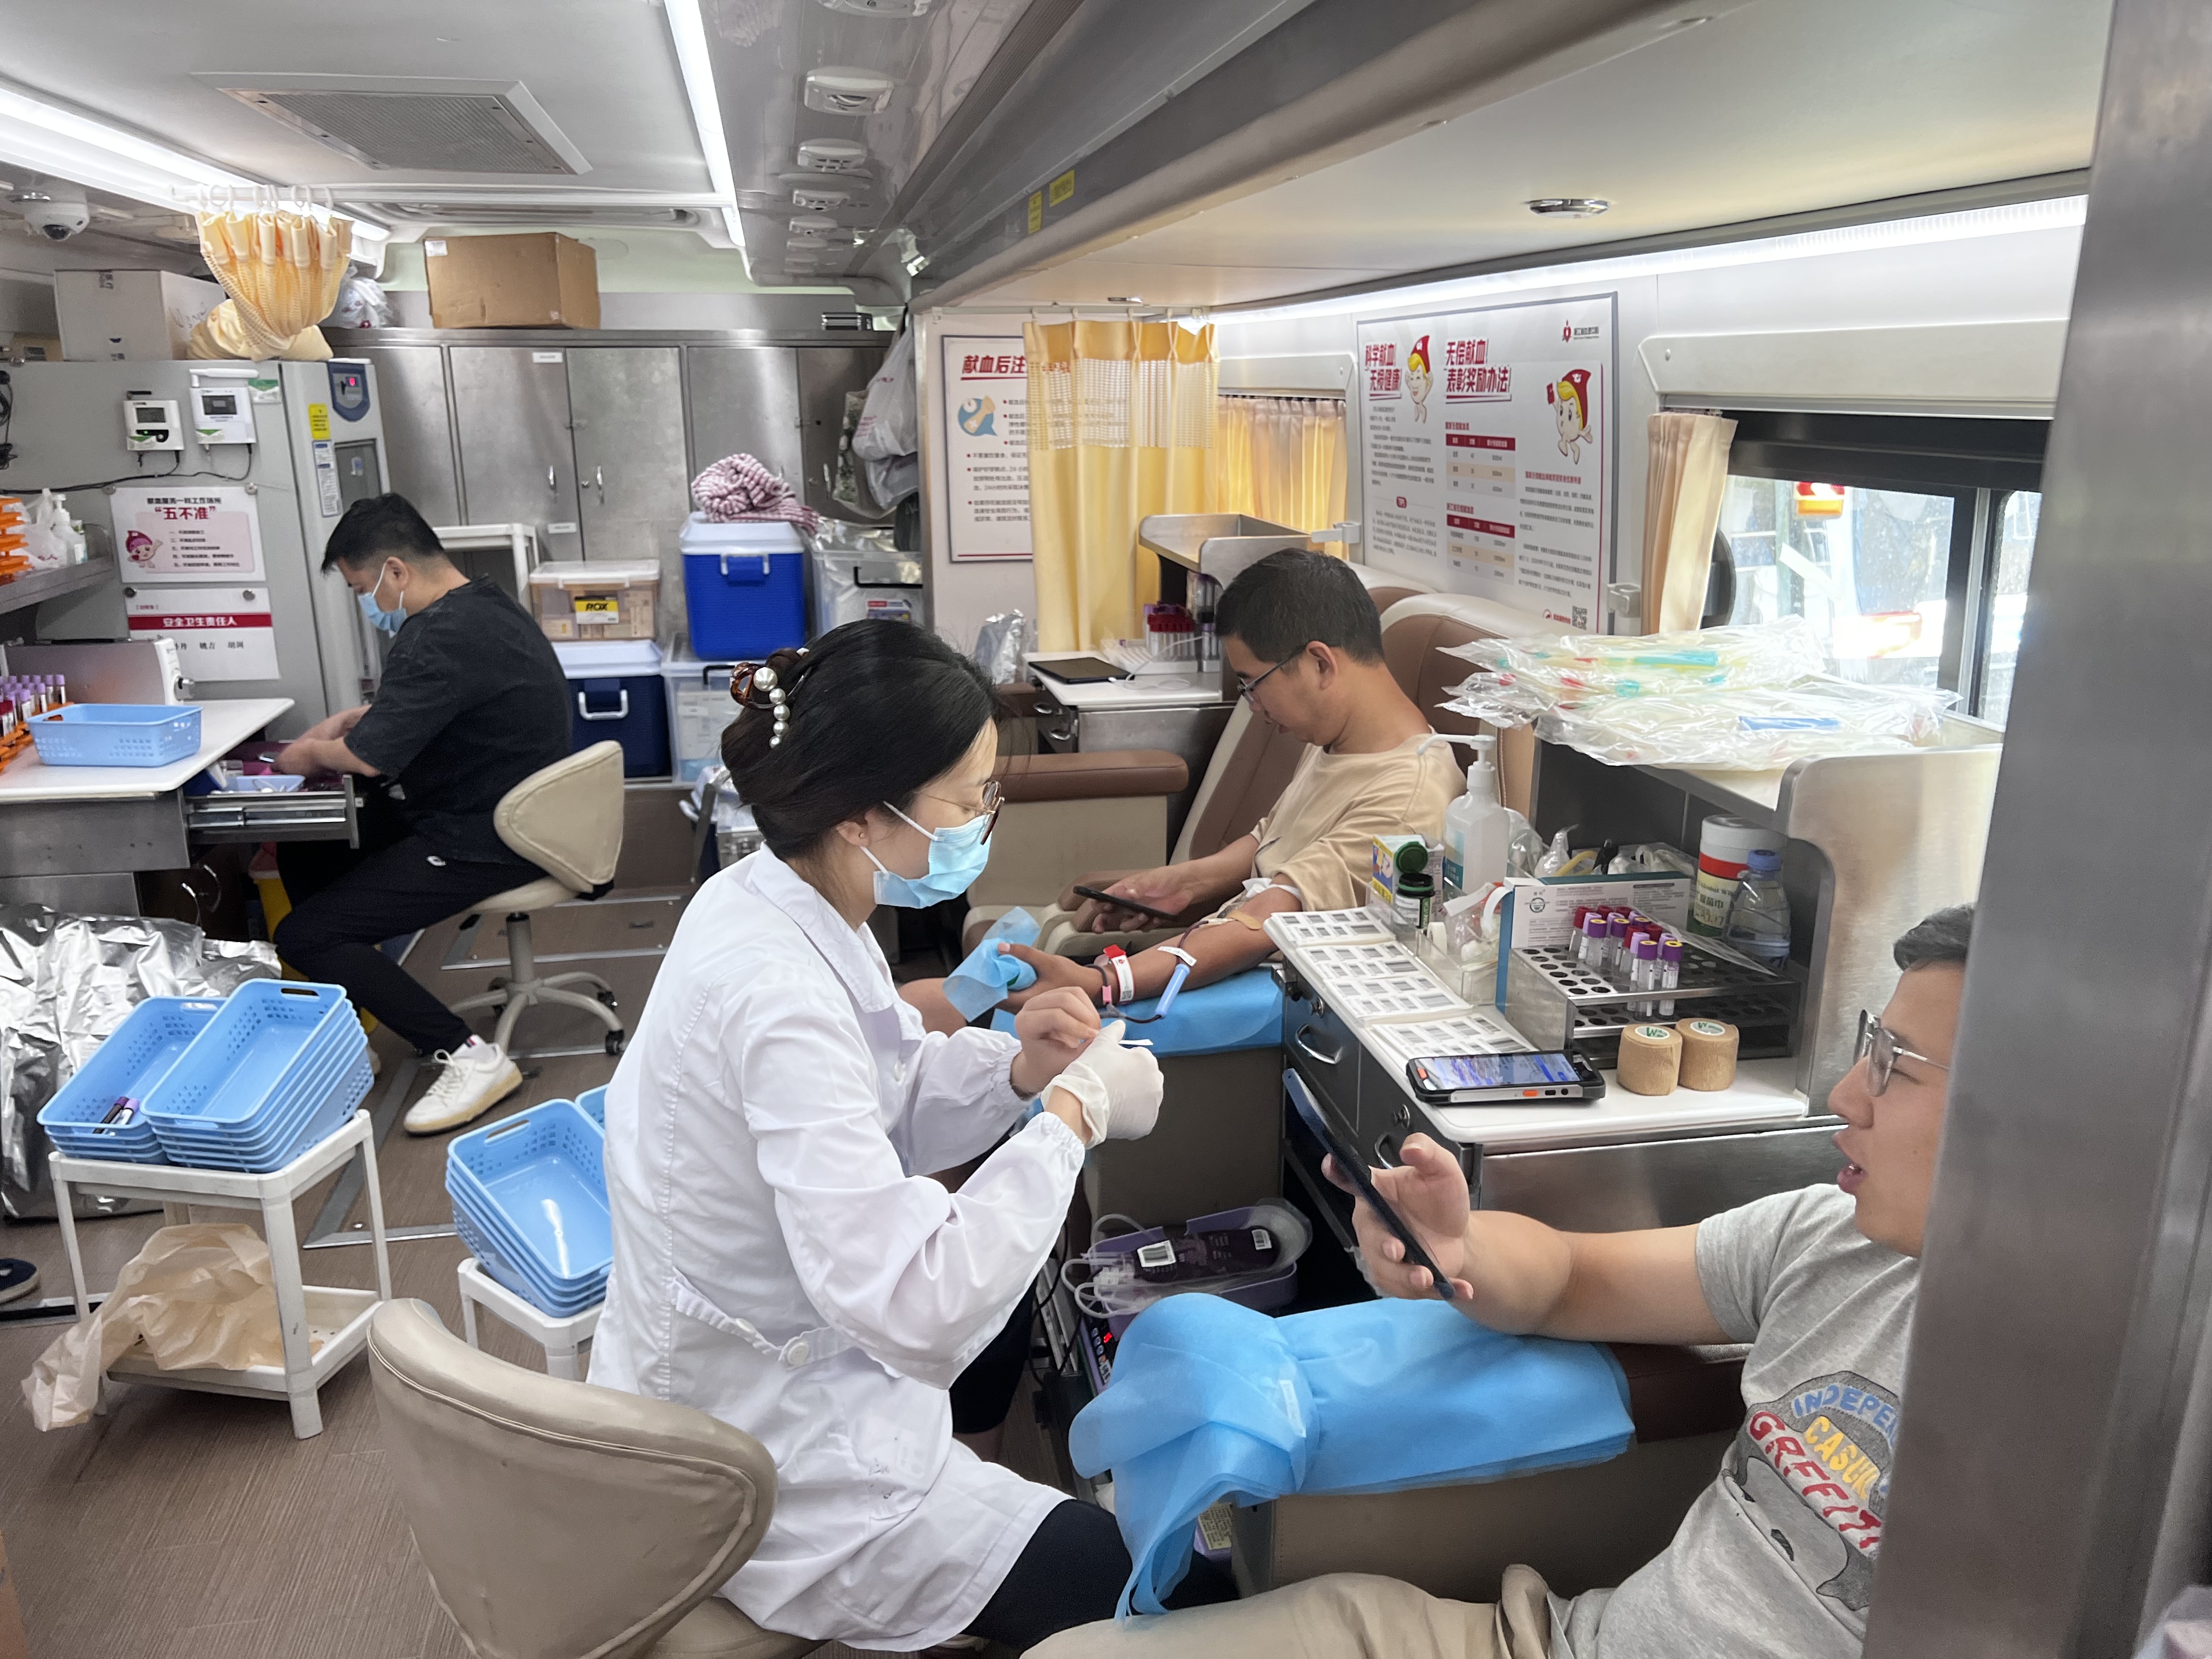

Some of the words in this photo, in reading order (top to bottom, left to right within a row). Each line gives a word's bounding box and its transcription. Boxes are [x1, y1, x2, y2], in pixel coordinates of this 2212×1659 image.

[1365, 344, 1395, 366] 科学献血
[1446, 340, 1486, 365] 无偿献血
[962, 355, 1026, 374] 献血后注
[1446, 366, 1509, 392] 表彰奖励办法
[163, 617, 238, 628] 安全卫生责任人
